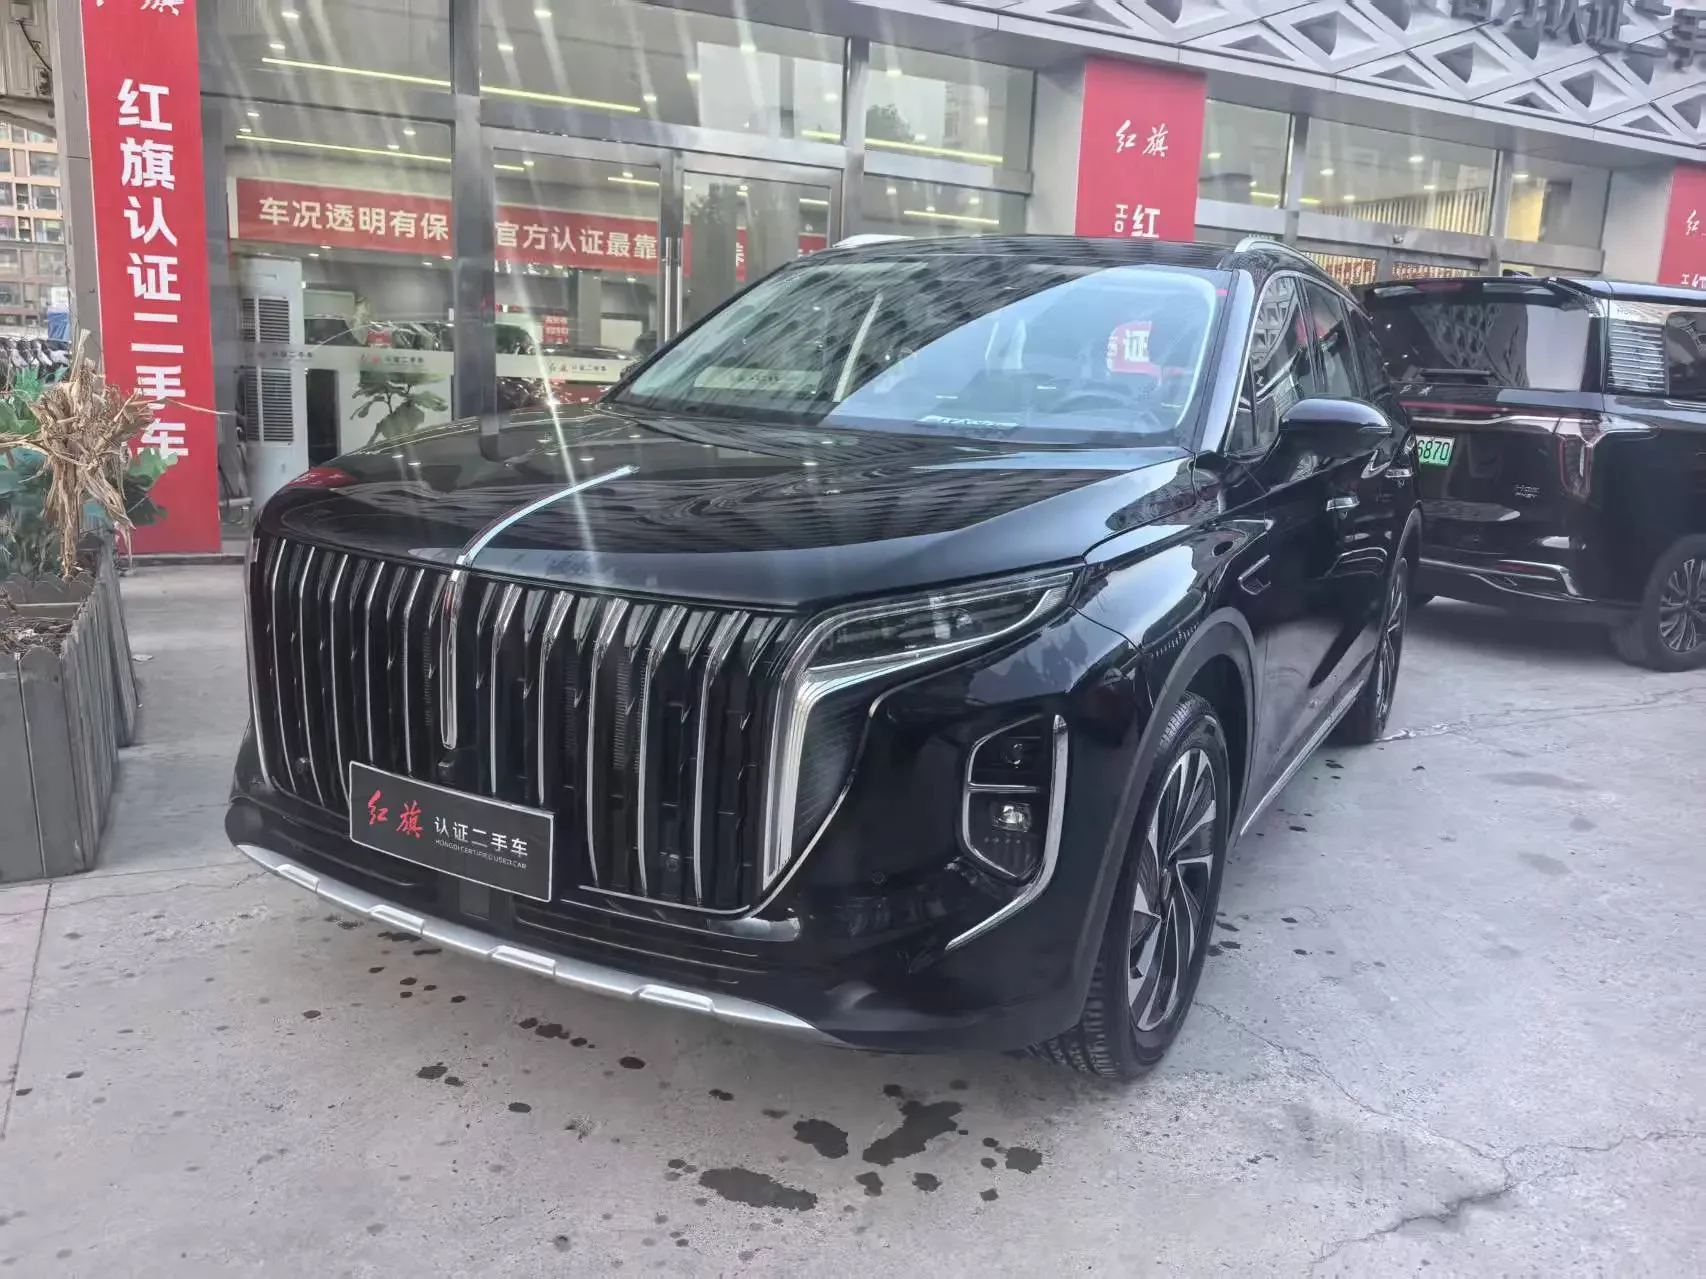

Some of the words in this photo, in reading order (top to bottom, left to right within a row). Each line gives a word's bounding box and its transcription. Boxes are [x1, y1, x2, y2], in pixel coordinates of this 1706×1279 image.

[1115, 119, 1168, 157] 红旗
[259, 197, 449, 241] 车况透明有保
[1131, 204, 1161, 238] 红
[495, 221, 657, 259] 官方认证最靠
[117, 78, 189, 460] 红旗认证二手车
[367, 790, 424, 840] 红旗
[434, 816, 528, 858] 认证二手车
